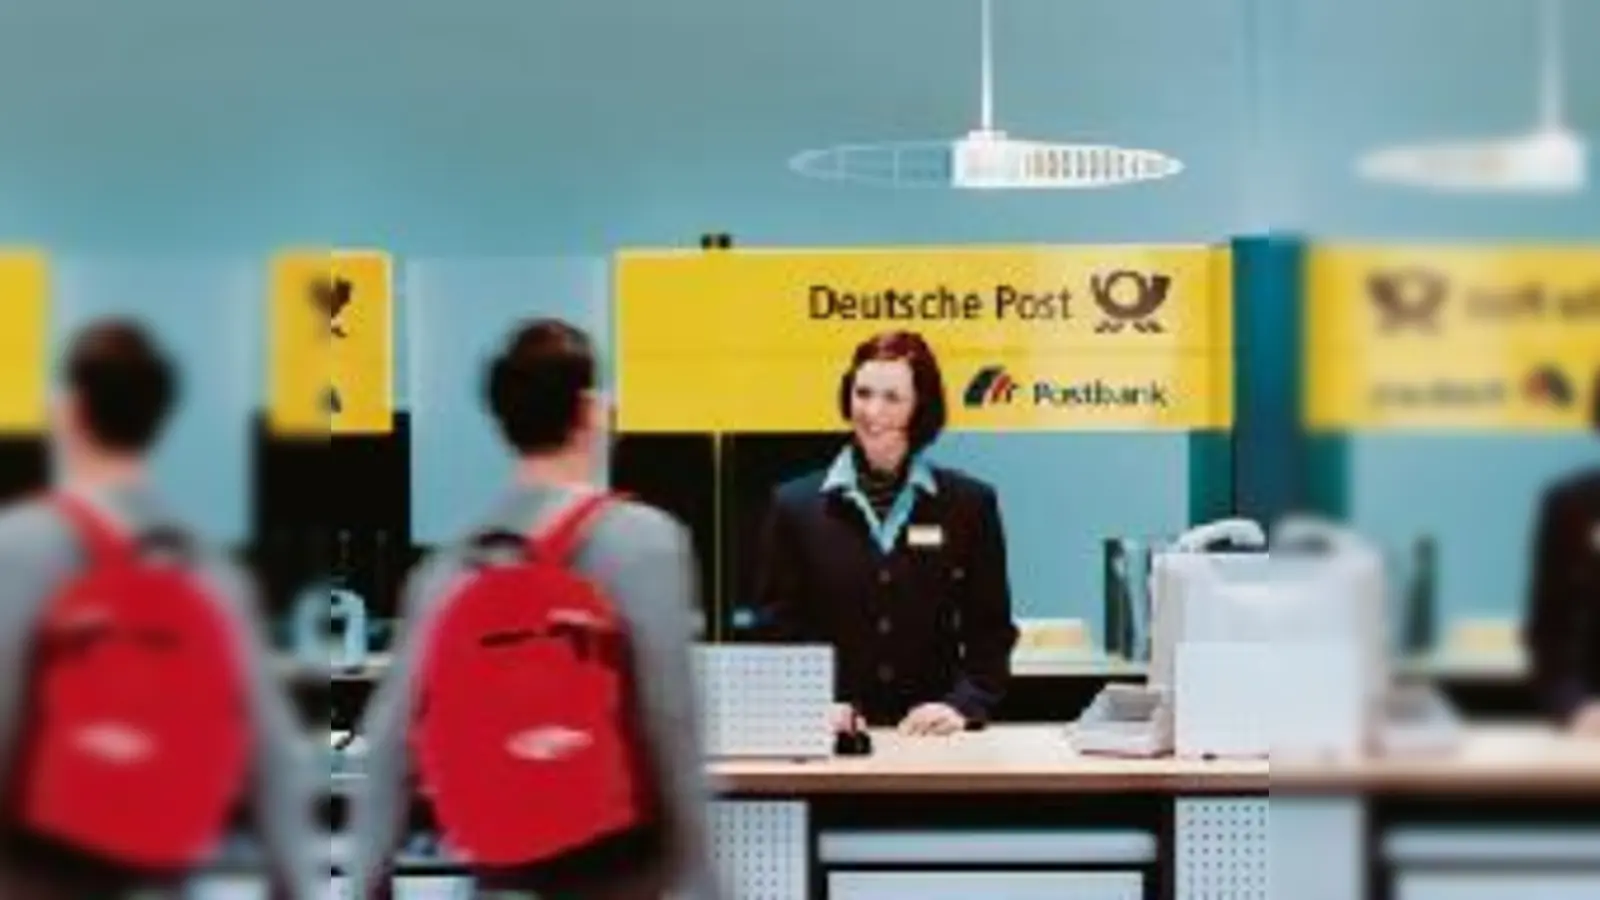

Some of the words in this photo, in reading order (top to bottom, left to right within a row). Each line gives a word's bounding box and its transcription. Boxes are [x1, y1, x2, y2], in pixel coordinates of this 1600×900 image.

[808, 284, 982, 321] Deutsche
[995, 285, 1073, 321] Post
[1033, 380, 1168, 408] Postbank
